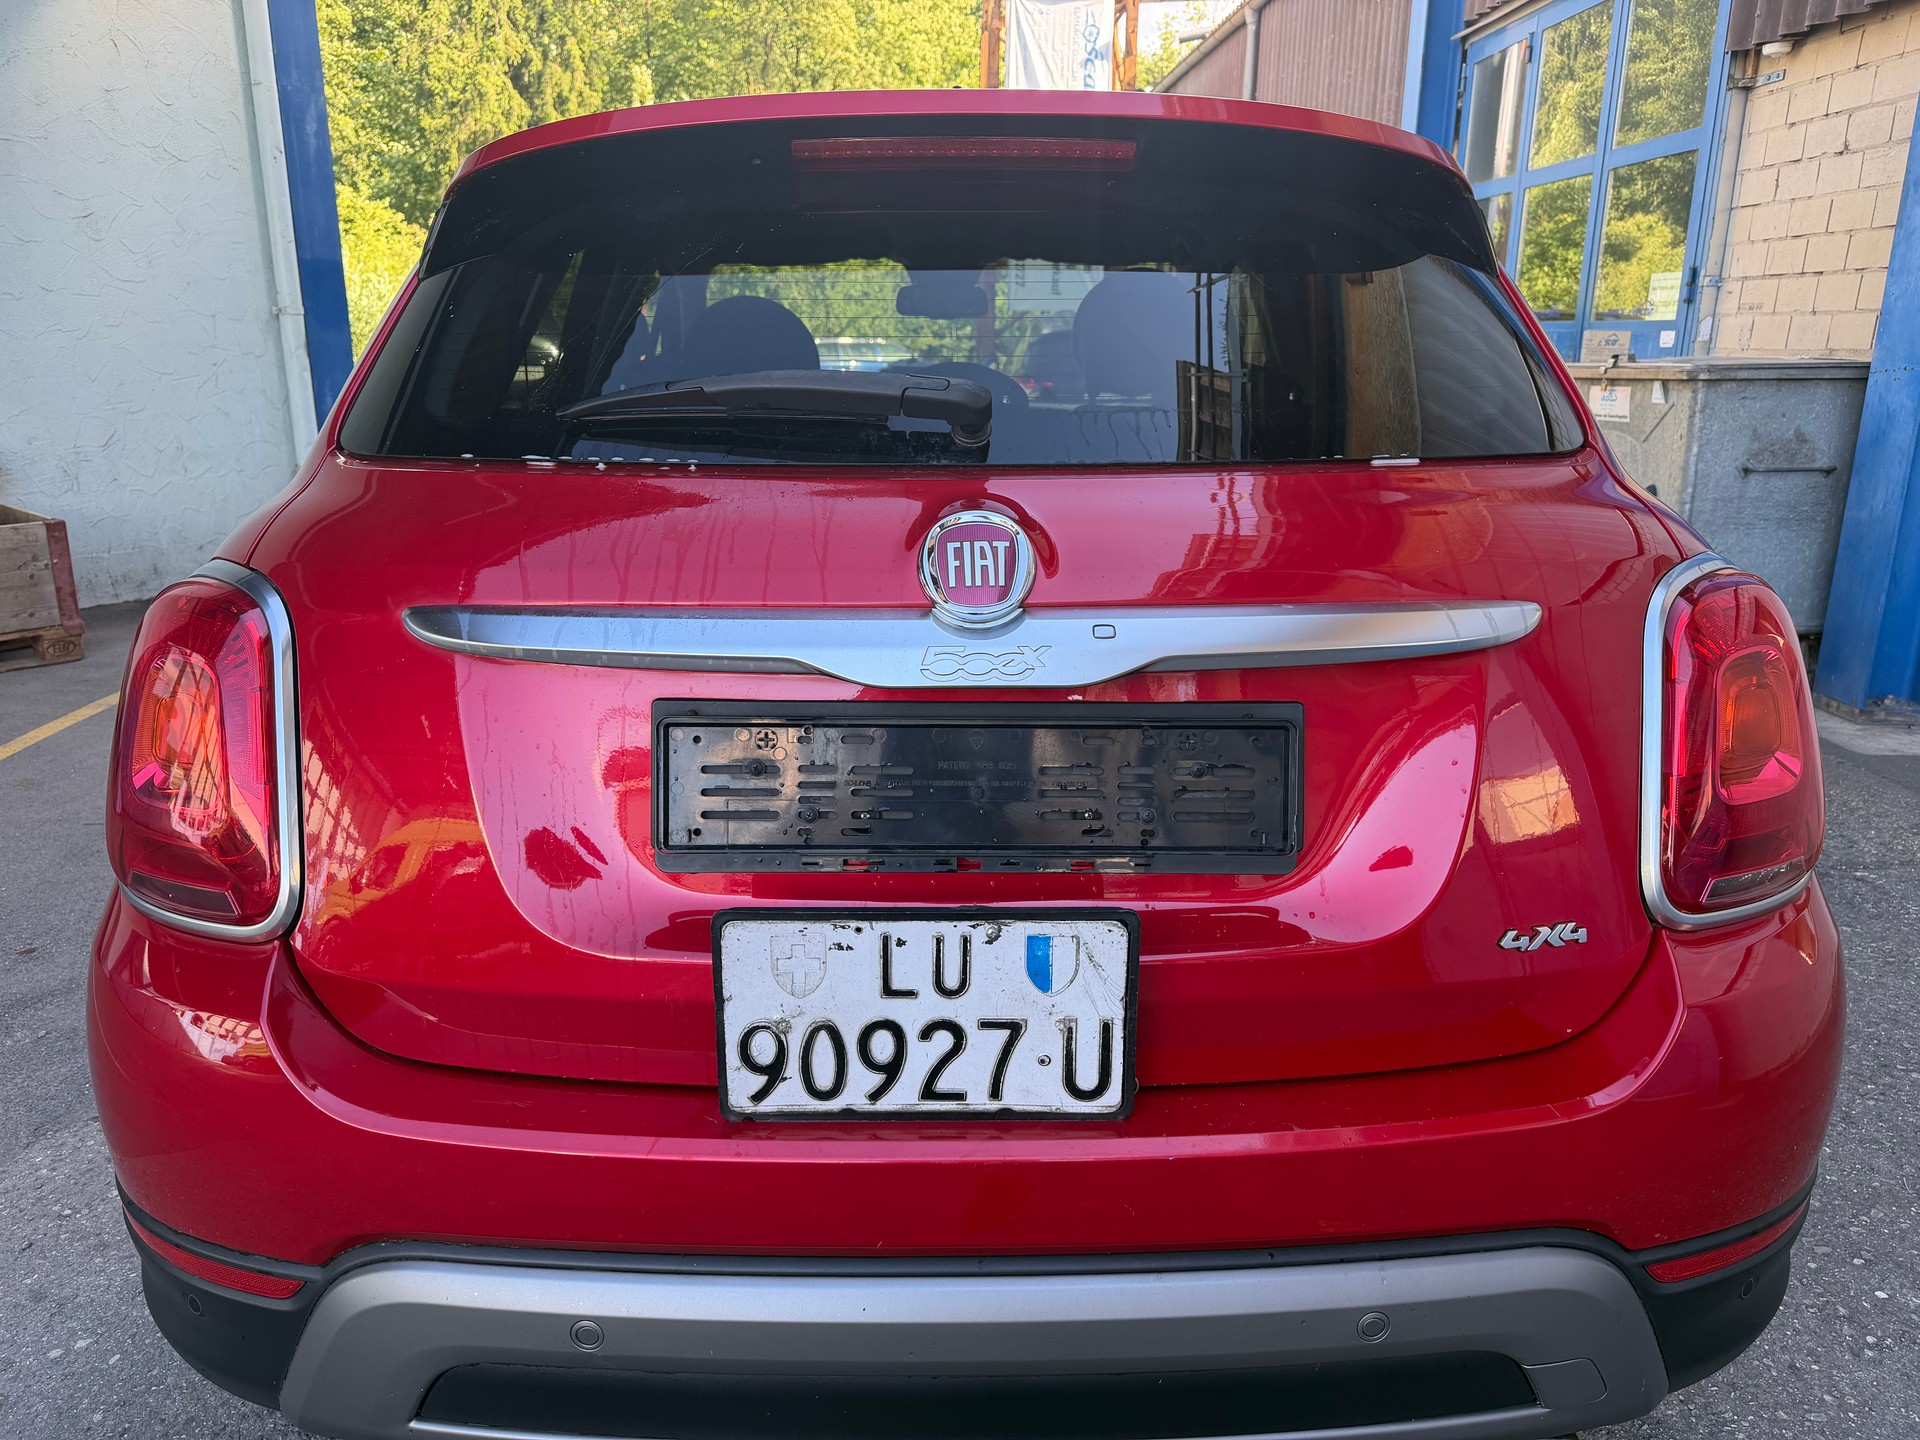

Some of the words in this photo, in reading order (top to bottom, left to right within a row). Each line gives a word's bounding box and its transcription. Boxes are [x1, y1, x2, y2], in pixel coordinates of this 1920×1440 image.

[946, 540, 1011, 588] FIAT
[880, 931, 971, 999] LU
[737, 1017, 1028, 1106] 90927
[1062, 1016, 1114, 1102] U
